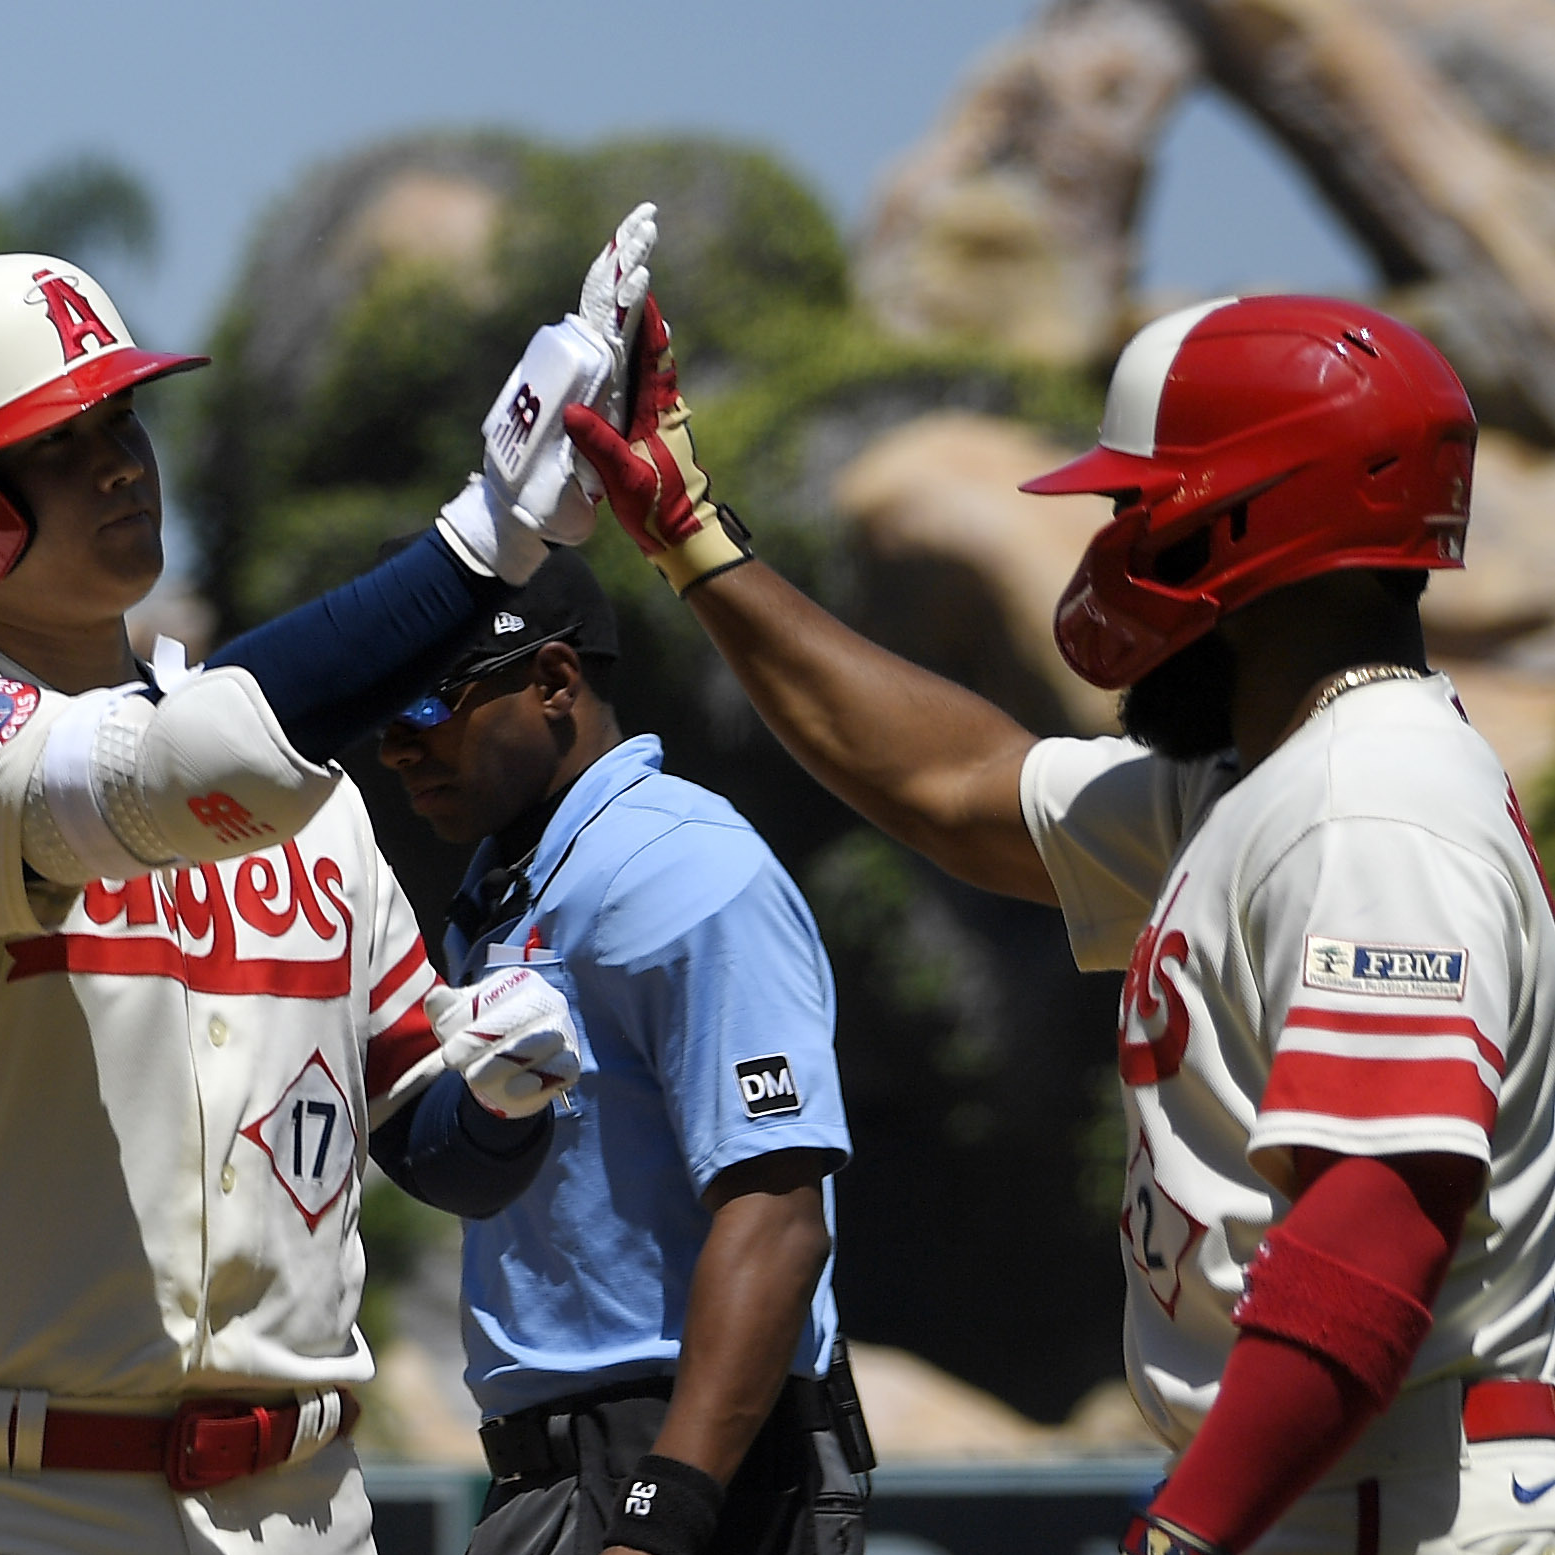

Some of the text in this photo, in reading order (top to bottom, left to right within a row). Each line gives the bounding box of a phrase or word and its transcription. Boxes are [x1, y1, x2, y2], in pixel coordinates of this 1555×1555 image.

[32, 268, 119, 366] A
[1362, 951, 1453, 982] FBM
[740, 1067, 794, 1103] DM
[292, 1099, 337, 1180] 17
[1137, 1184, 1167, 1269] 2
